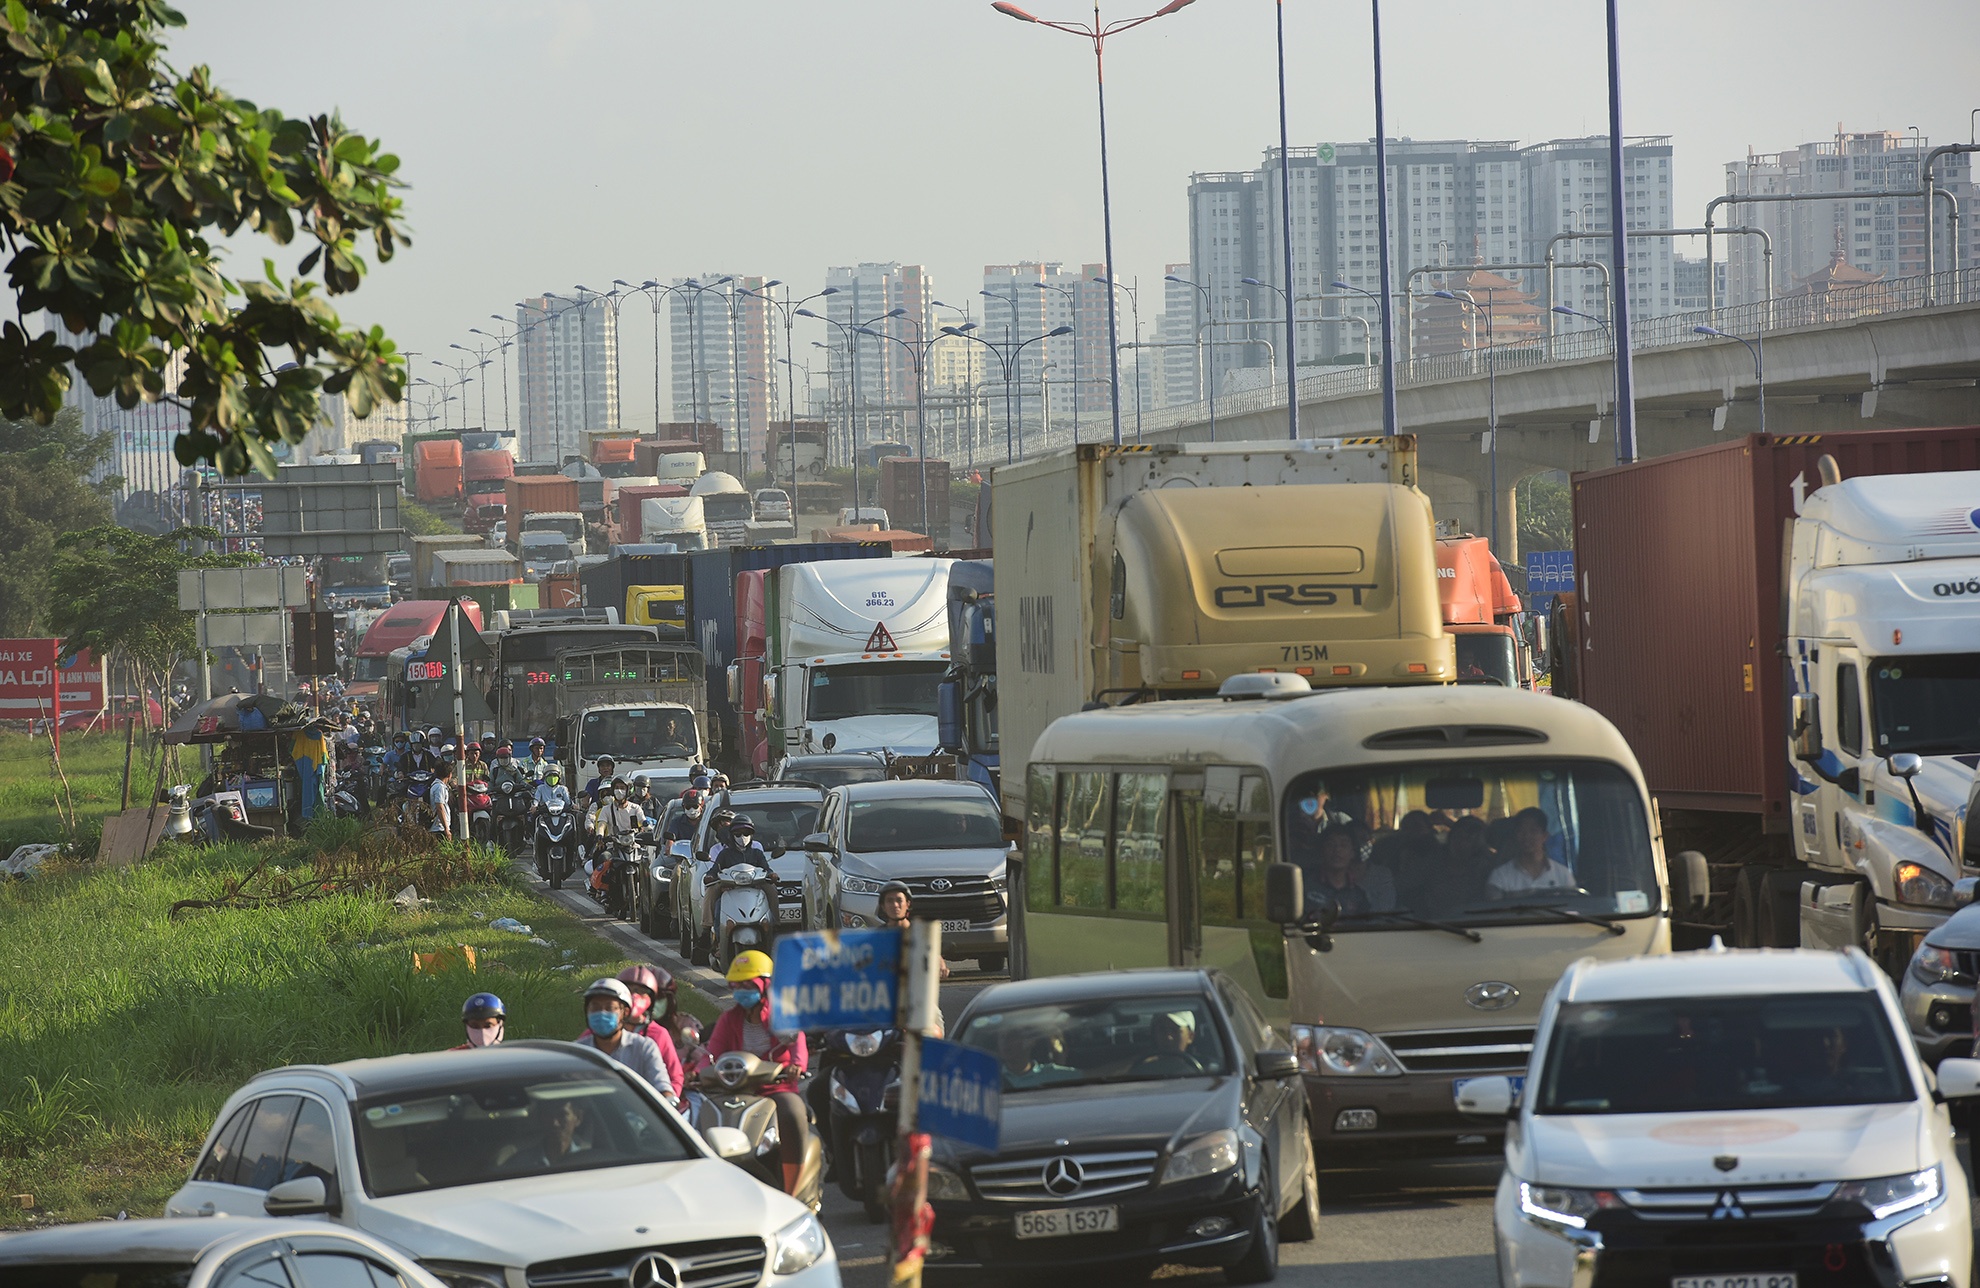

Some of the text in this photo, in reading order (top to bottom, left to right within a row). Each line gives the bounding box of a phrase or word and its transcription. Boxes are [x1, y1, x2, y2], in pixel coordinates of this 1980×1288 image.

[871, 591, 887, 599] 61C
[1214, 583, 1378, 608] CRST
[865, 599, 895, 607] 366.23
[18, 651, 32, 662] XE
[1280, 645, 1328, 661] 715M
[21, 665, 52, 687] LỢI
[409, 664, 425, 679] 150
[425, 661, 443, 679] 150
[527, 671, 550, 685] 30
